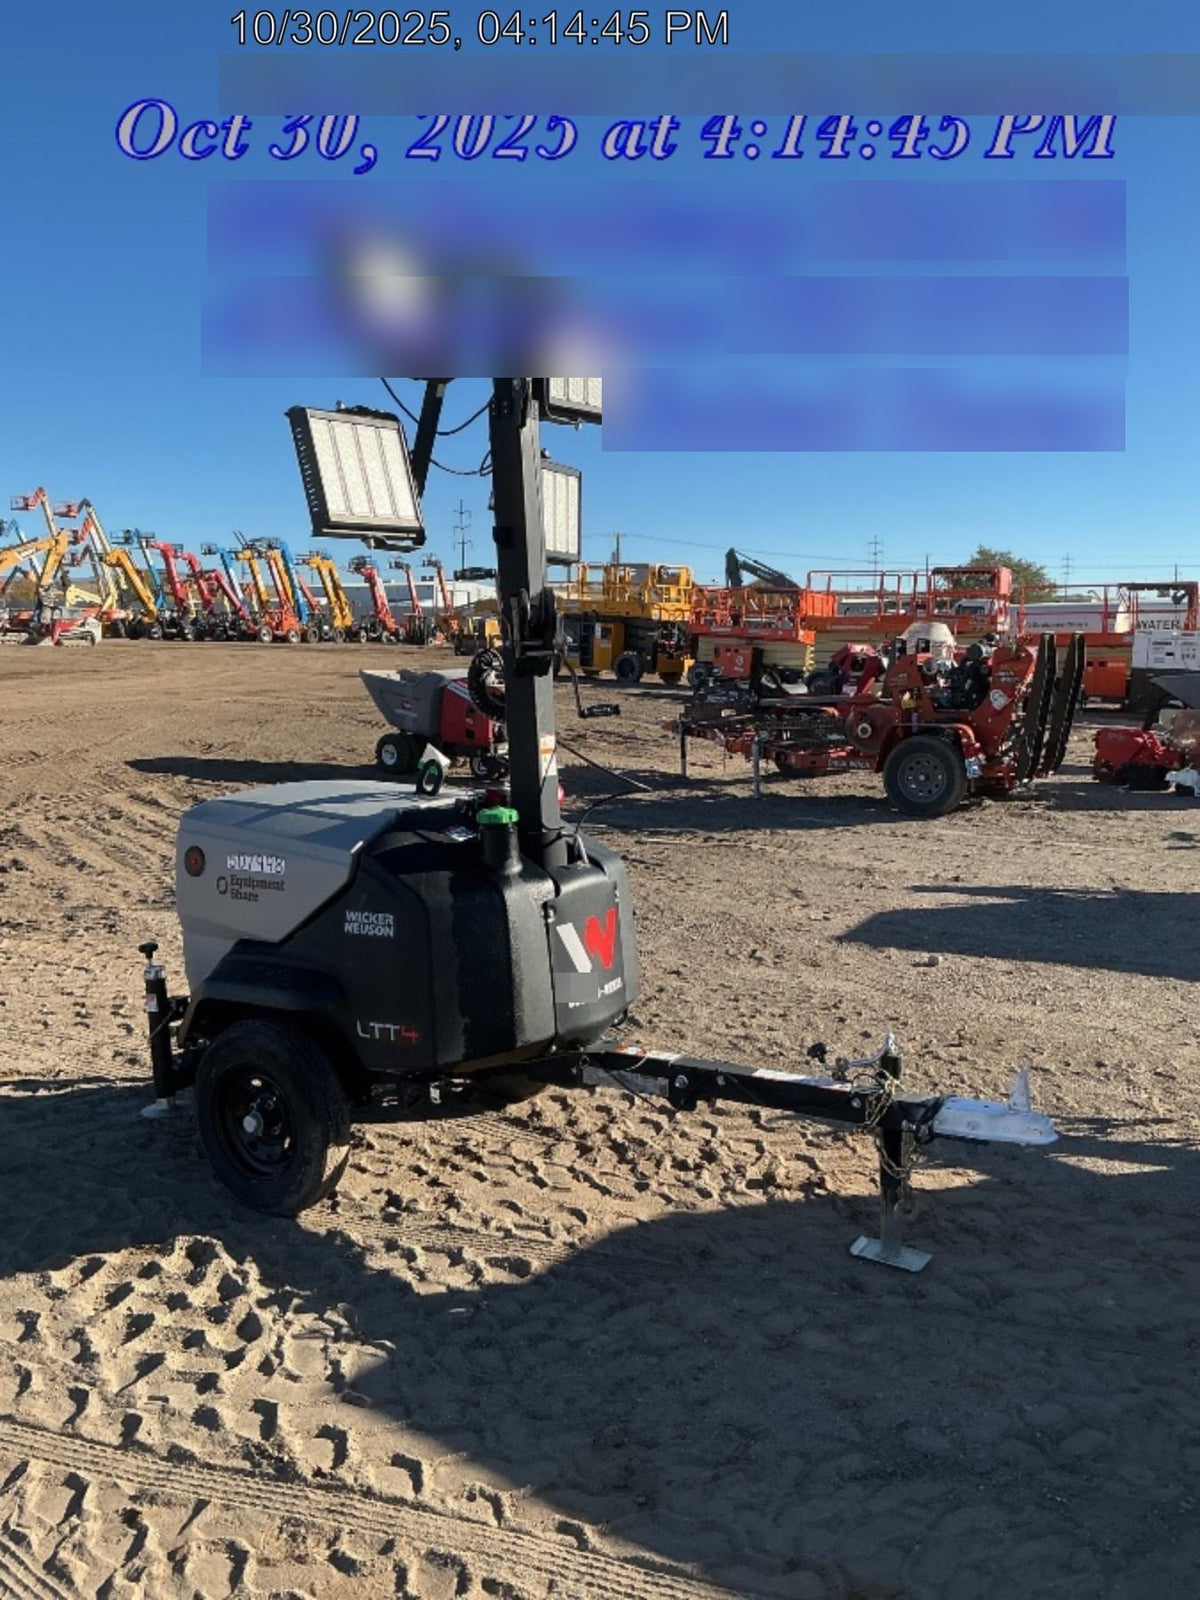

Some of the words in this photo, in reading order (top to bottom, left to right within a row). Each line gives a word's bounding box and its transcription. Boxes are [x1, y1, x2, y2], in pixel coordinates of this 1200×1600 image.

[230, 874, 286, 892] Equipment
[344, 922, 394, 938] NEUSON
[356, 1020, 420, 1044] LTT4
